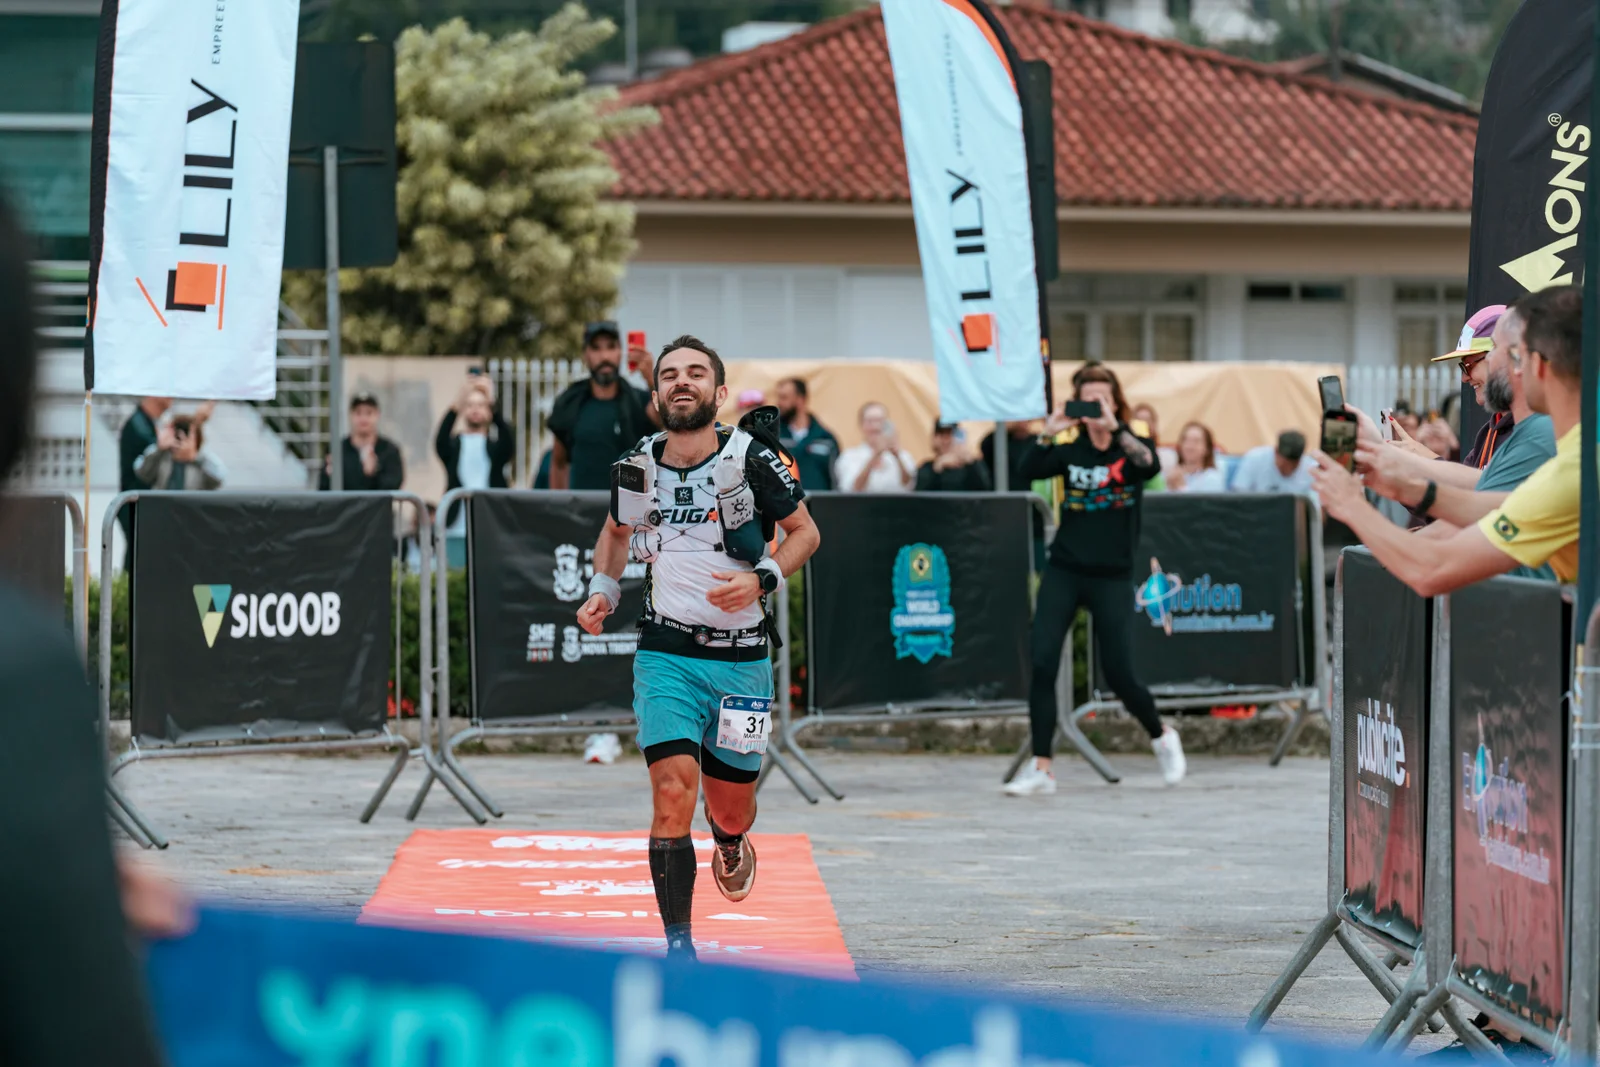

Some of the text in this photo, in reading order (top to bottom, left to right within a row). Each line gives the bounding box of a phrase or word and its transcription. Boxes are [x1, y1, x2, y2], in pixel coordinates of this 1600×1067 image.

[178, 0, 238, 248] LILY EMPREE
[945, 168, 992, 301] LILY
[758, 448, 796, 496] FUGA
[660, 507, 717, 524] FUGA
[230, 591, 341, 639] SICOOB
[664, 620, 680, 630] ULTRA
[680, 624, 693, 634] TOUR
[745, 716, 765, 734] 31
